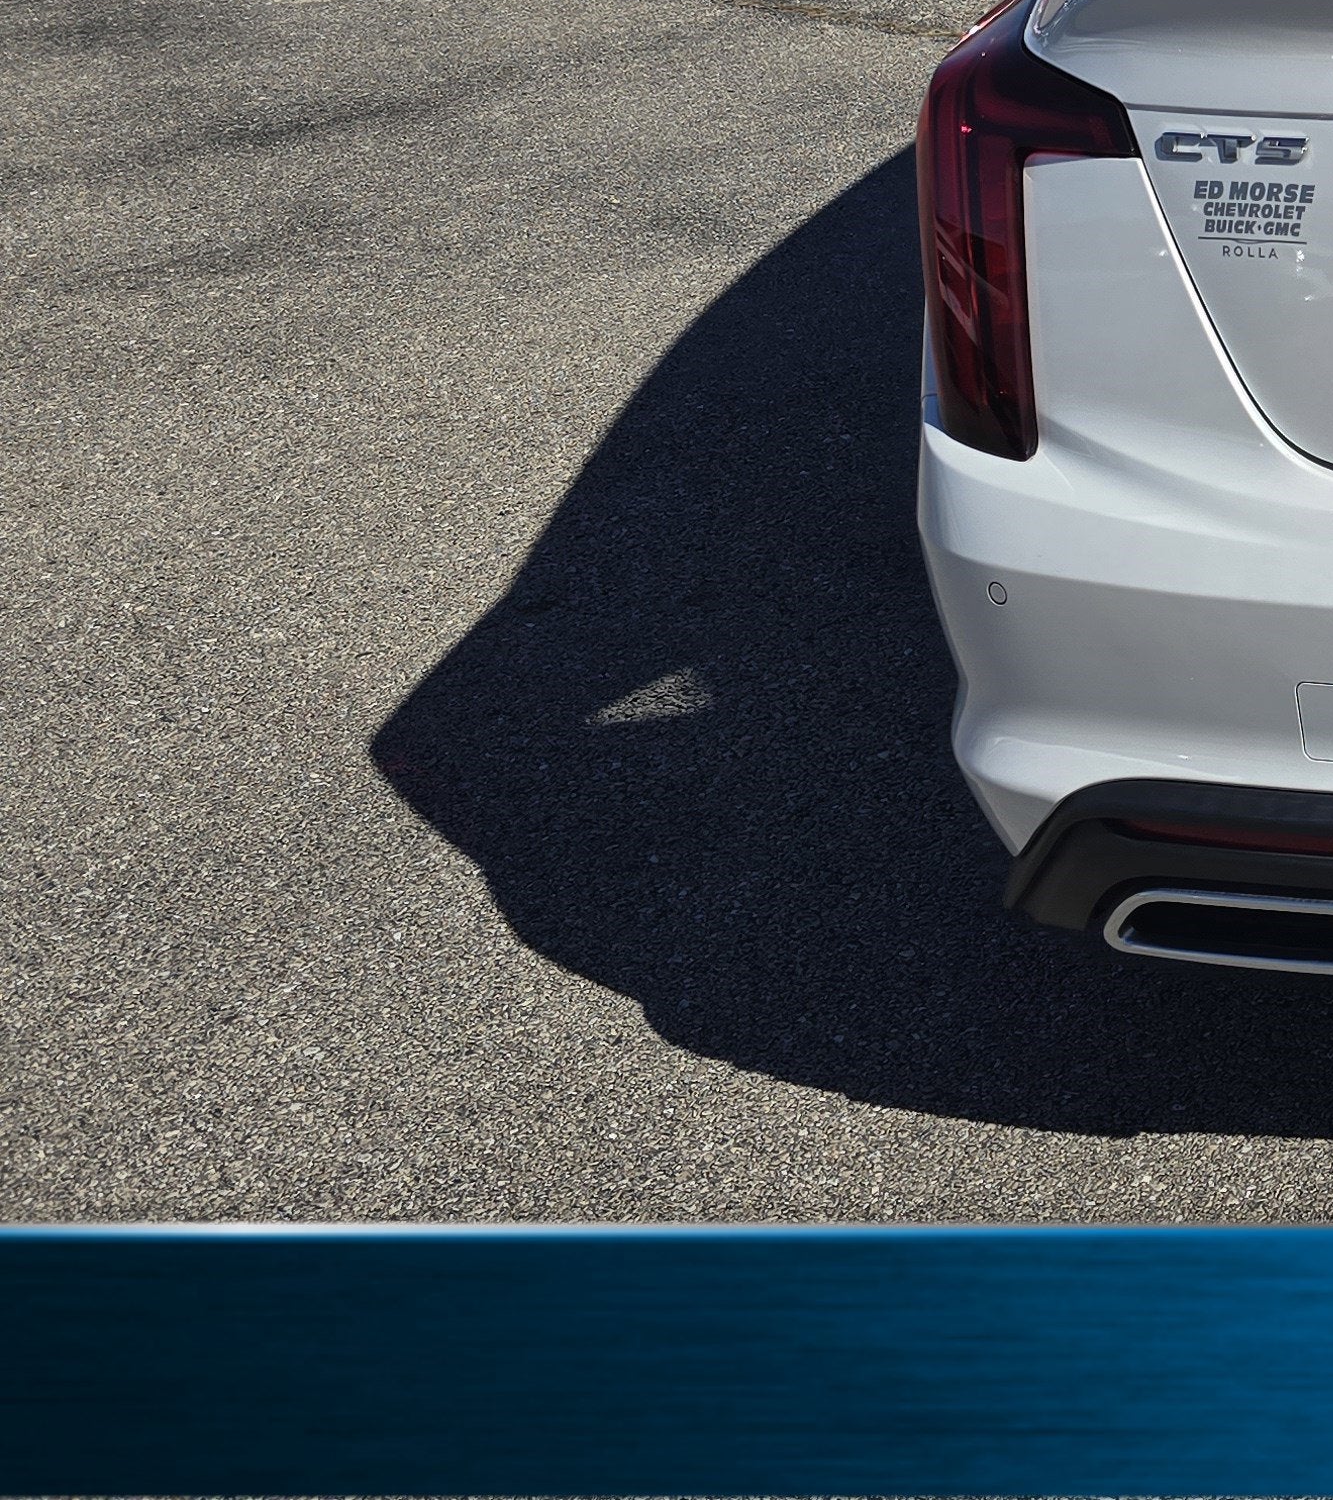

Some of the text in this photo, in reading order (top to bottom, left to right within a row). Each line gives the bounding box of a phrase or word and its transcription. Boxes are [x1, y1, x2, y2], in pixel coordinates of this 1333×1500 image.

[1193, 180, 1316, 204] ED MORSE
[1203, 202, 1306, 220] CHEVROLET
[1222, 244, 1279, 260] ROLLA
